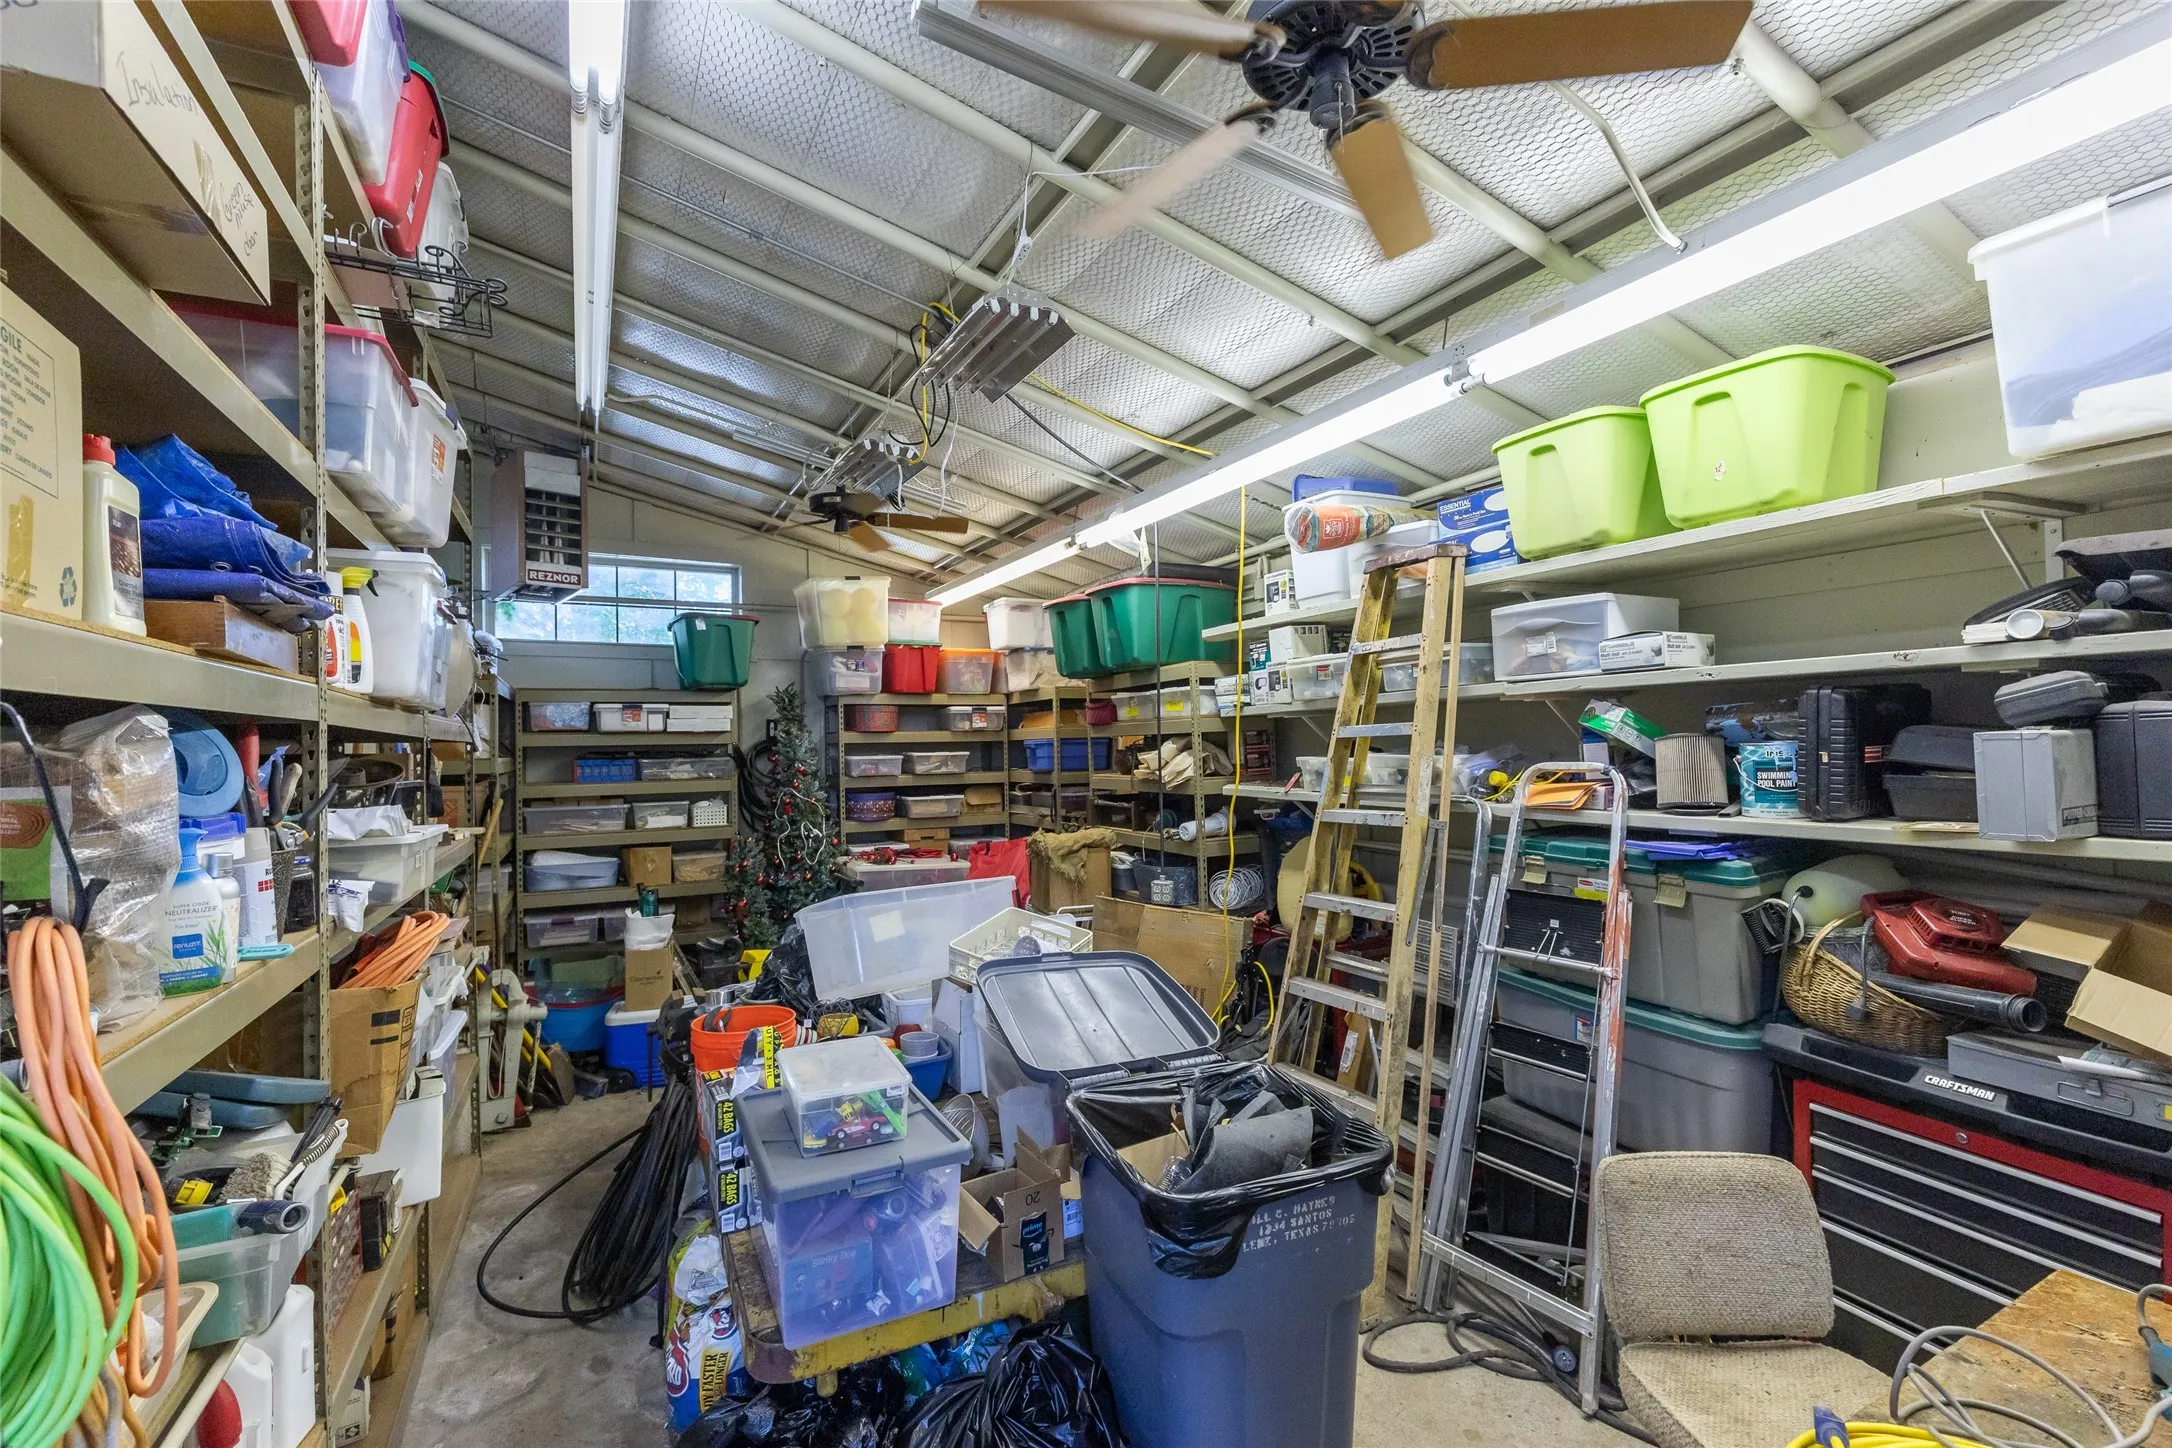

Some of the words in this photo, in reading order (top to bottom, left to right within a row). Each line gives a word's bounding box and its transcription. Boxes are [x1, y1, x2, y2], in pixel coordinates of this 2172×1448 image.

[1440, 499, 1472, 513] ESSENTIAL
[529, 570, 579, 584] REZNOR
[1757, 771, 1796, 780] SWIMMIN
[1757, 779, 1775, 788] POOL
[1776, 779, 1796, 788] PAINT
[165, 905, 218, 917] NEUTRALIZER
[1924, 1074, 1996, 1101] CRAFTSMAN
[723, 1101, 733, 1113] 42
[723, 1112, 734, 1134] BAGS
[726, 1173, 737, 1183] 42
[726, 1183, 737, 1205] BAGS
[1293, 1195, 1336, 1215] HAYNES
[1290, 1208, 1332, 1227] SANTOS
[1022, 1222, 1043, 1235] prime
[1284, 1224, 1318, 1241] TEXAS
[811, 1253, 838, 1268] Slinky
[840, 1249, 857, 1261] Dog
[702, 1353, 718, 1392] FASTER
[714, 1352, 729, 1383] LONGER
